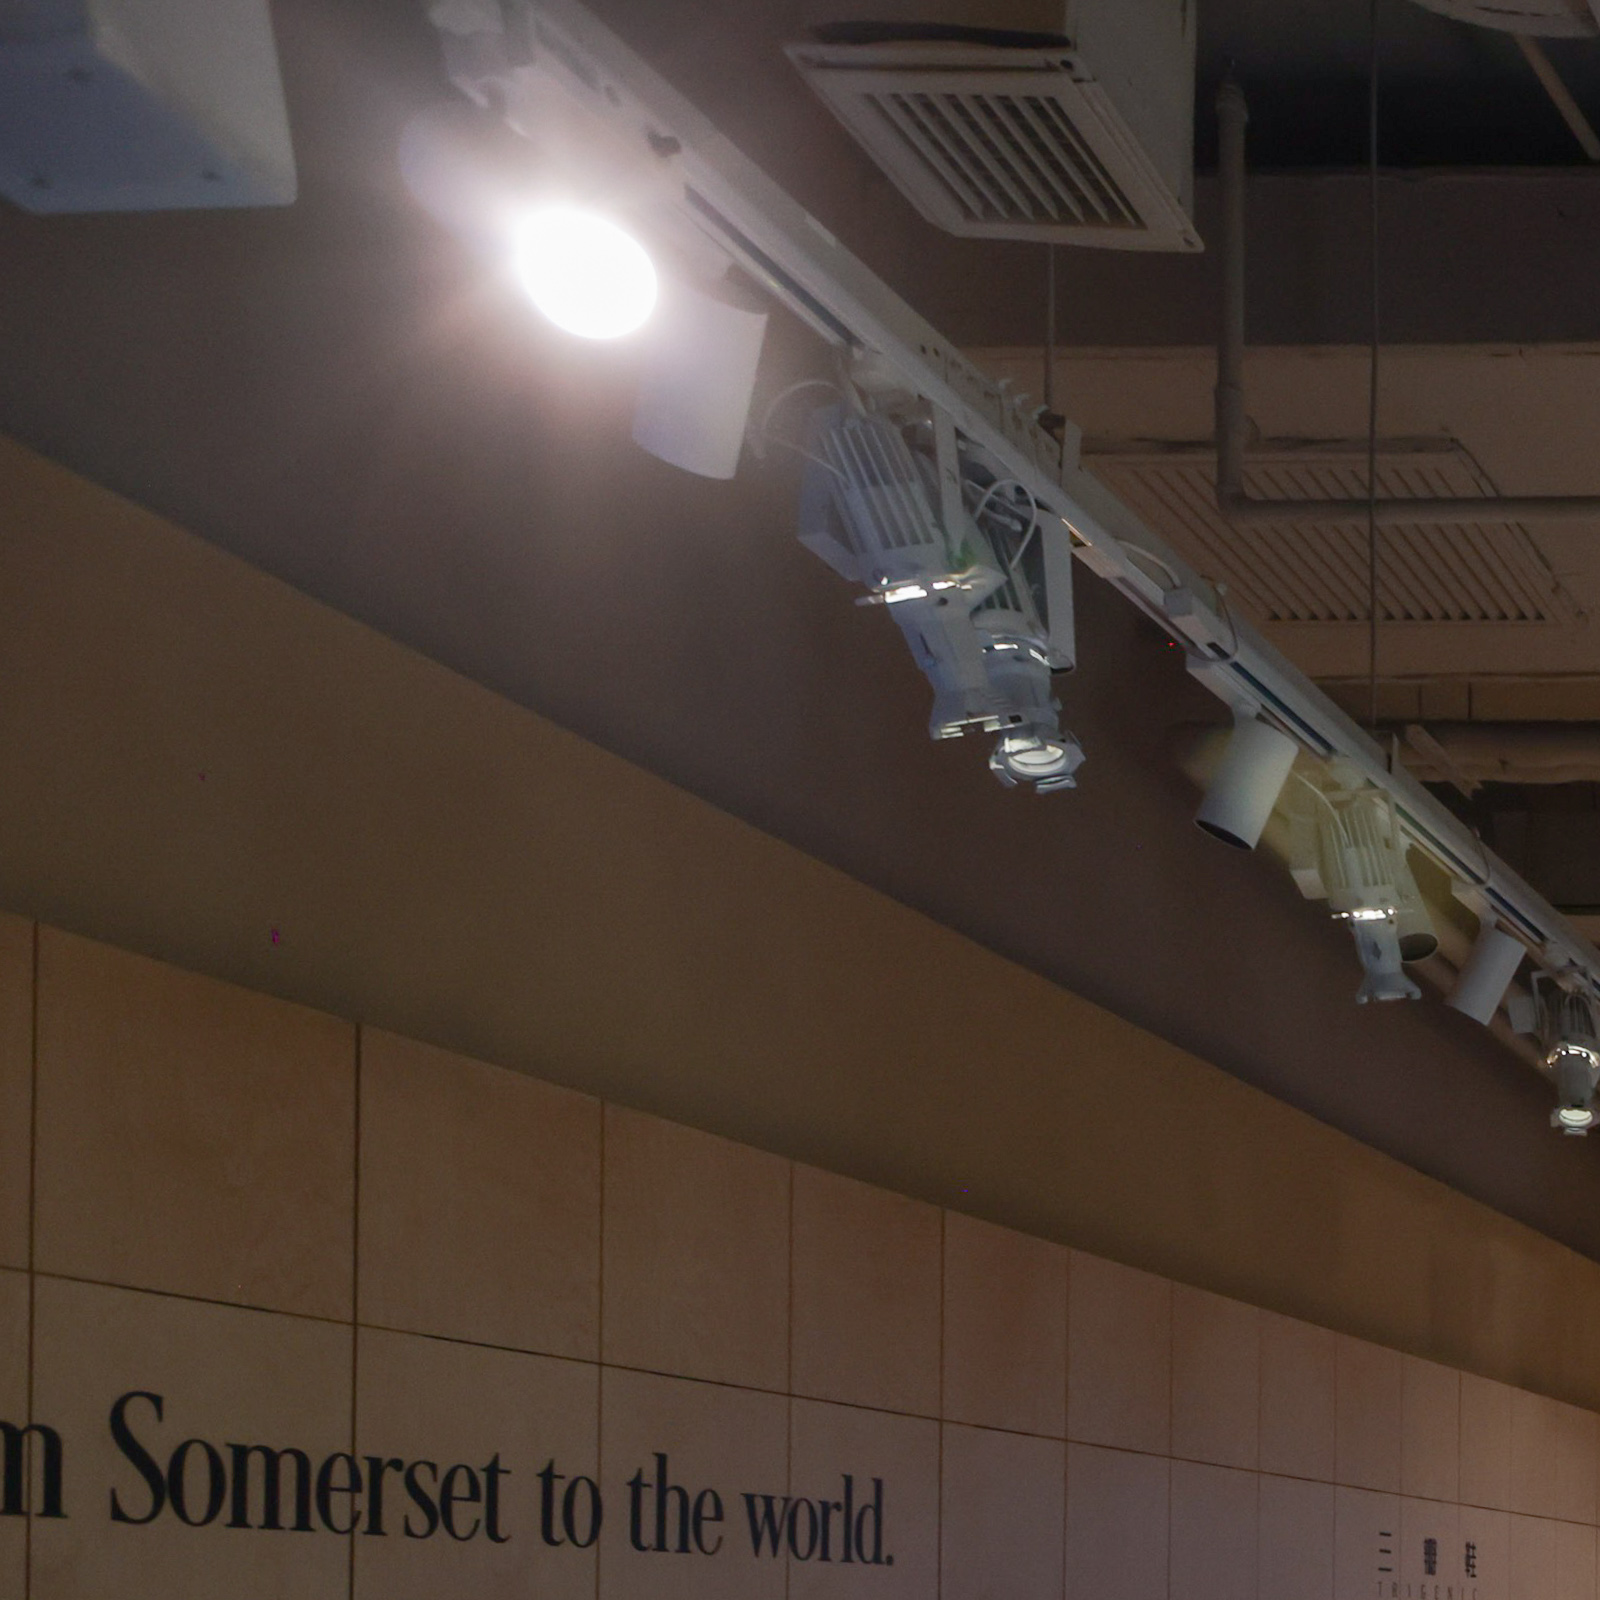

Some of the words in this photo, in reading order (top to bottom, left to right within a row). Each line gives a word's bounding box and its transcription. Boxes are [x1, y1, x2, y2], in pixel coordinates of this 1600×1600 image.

[108, 1390, 513, 1544] Somerset
[536, 1457, 604, 1549] to
[626, 1452, 725, 1556] the
[740, 1473, 896, 1567] world.
